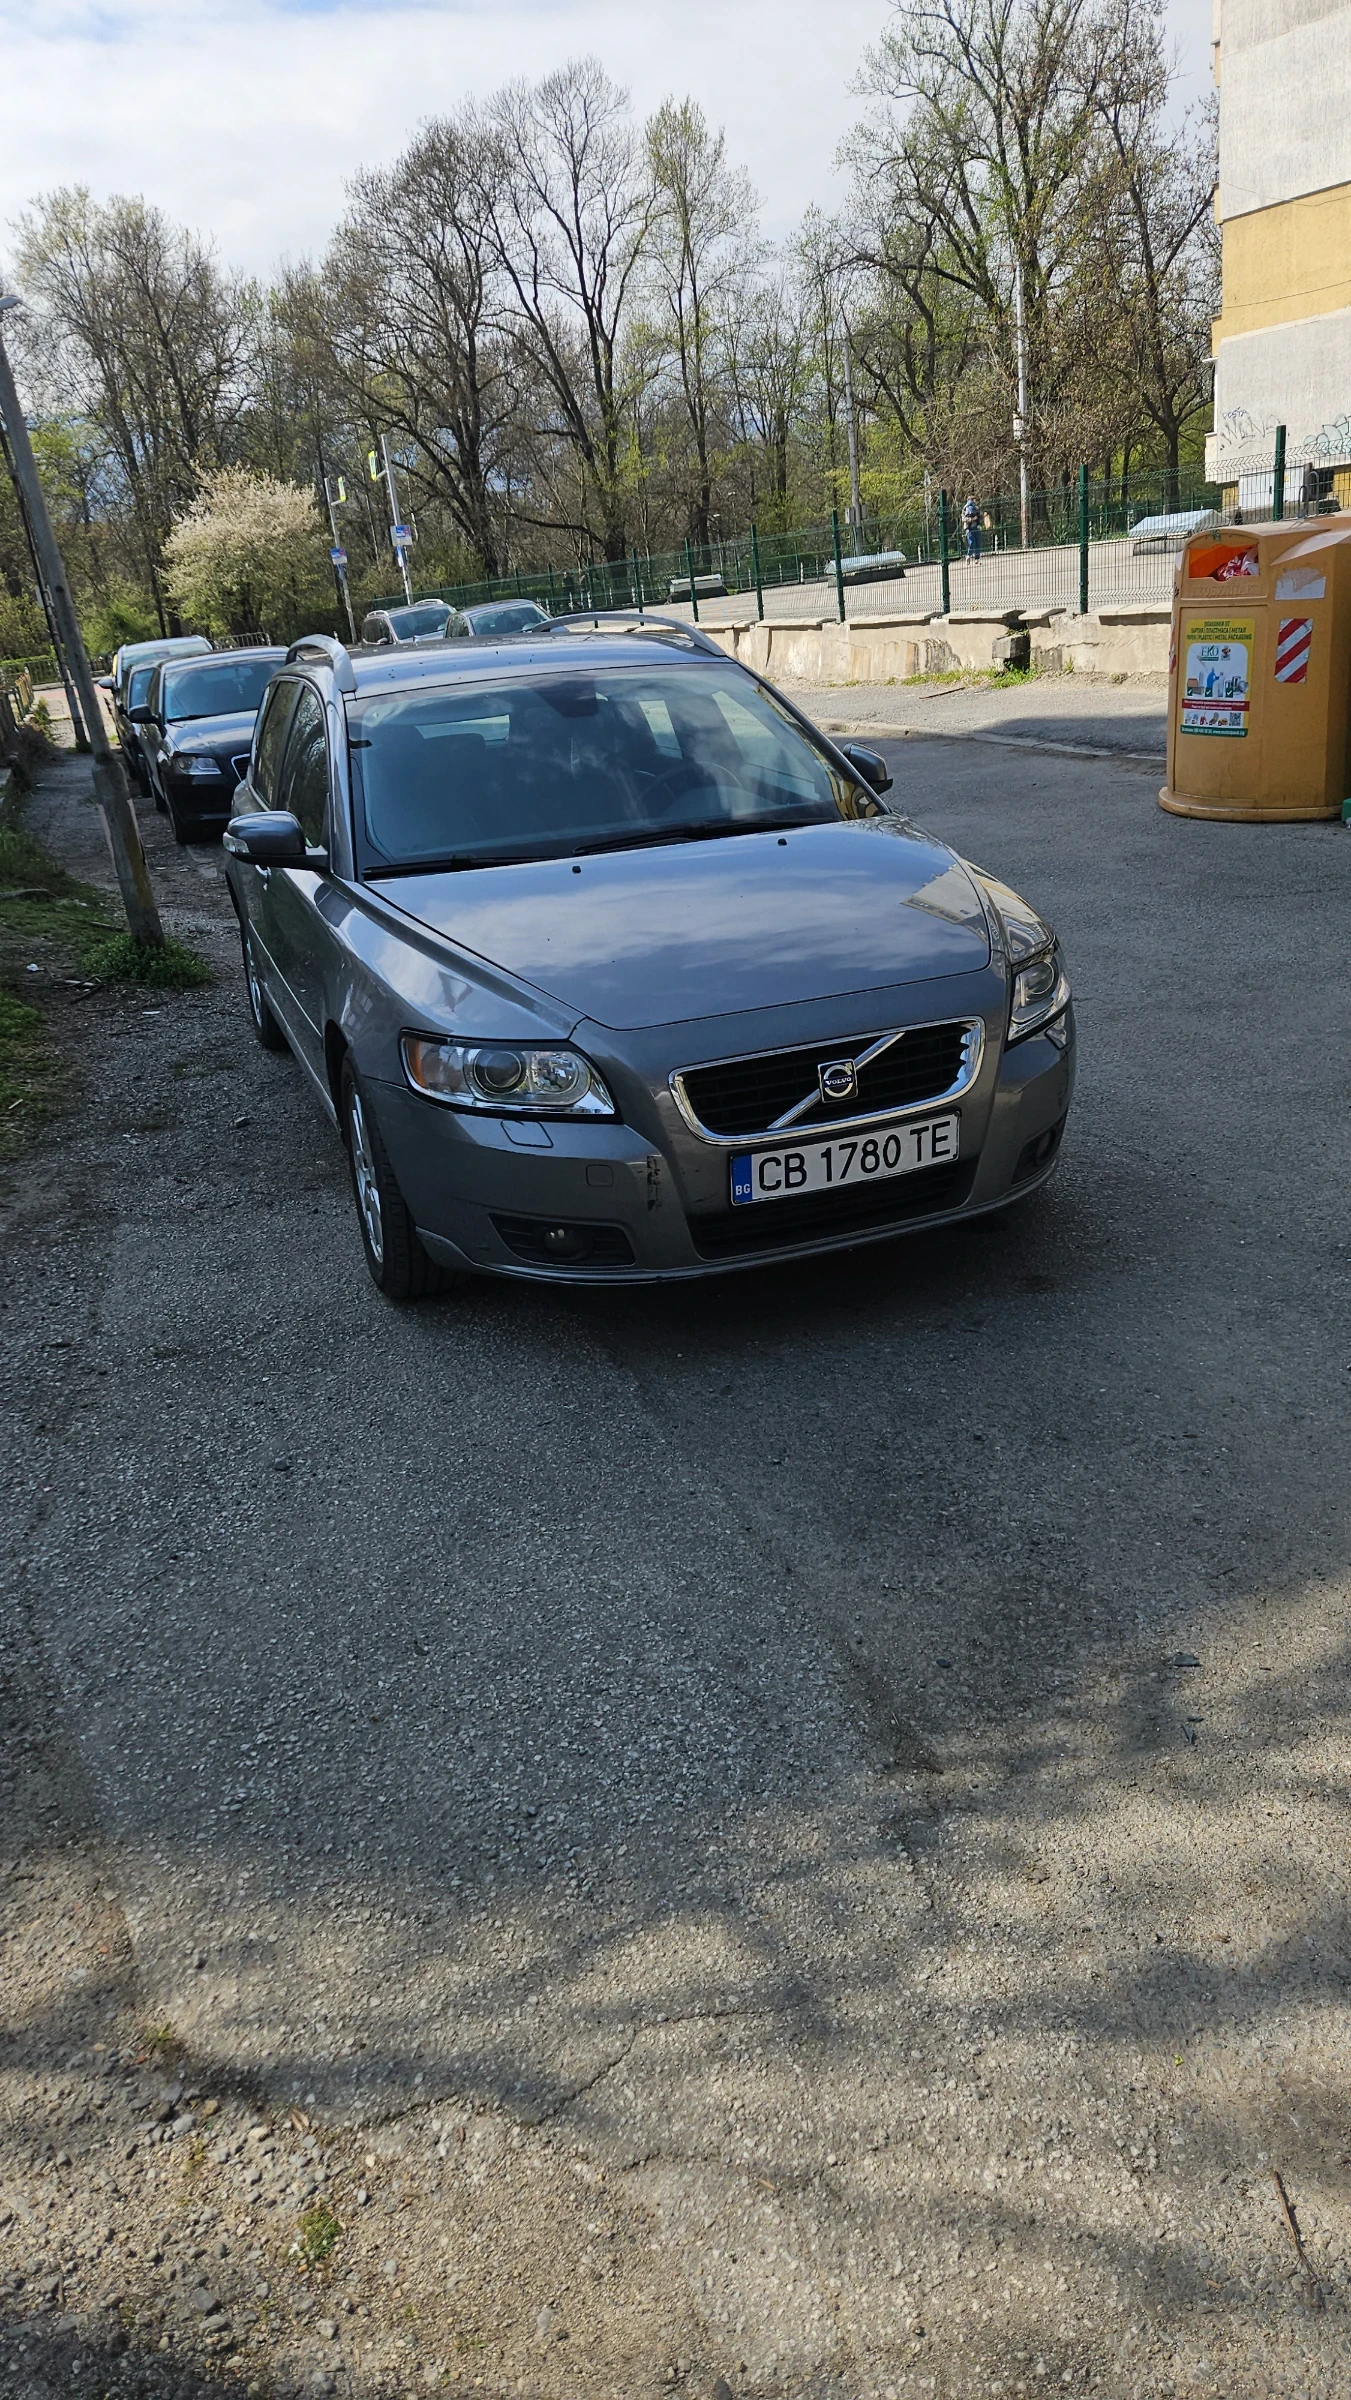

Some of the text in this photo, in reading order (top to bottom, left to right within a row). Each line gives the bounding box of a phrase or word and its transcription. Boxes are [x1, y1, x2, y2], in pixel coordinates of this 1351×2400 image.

[825, 1077, 852, 1086] VOLVO
[758, 1121, 951, 1191] CB 1780 TE
[735, 1184, 751, 1196] BG
